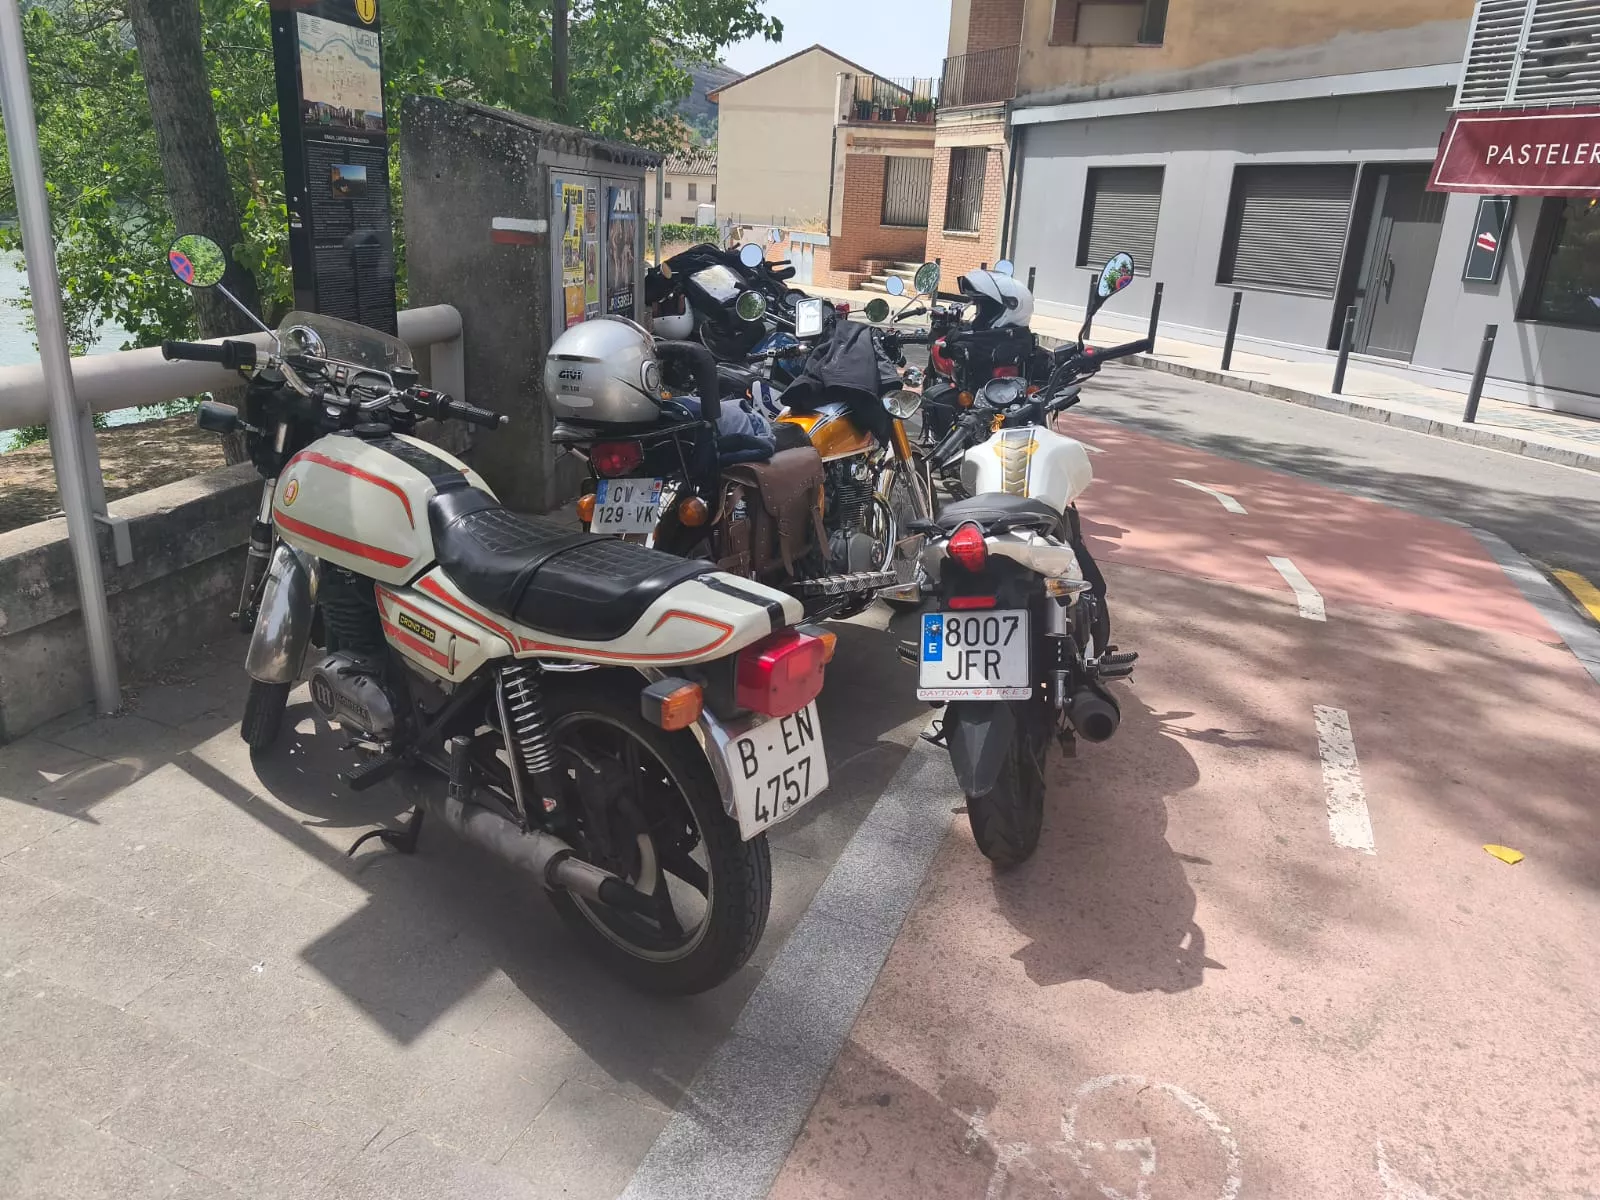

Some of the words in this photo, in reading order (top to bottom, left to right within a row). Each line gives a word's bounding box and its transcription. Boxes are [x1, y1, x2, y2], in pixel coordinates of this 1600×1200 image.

[1486, 143, 1600, 165] PASTELER
[613, 486, 634, 503] CW
[945, 615, 1019, 647] 8007
[928, 642, 938, 654] E
[946, 649, 1001, 681] JFR
[919, 689, 970, 697] DAYTONA
[754, 756, 811, 823] 4757
